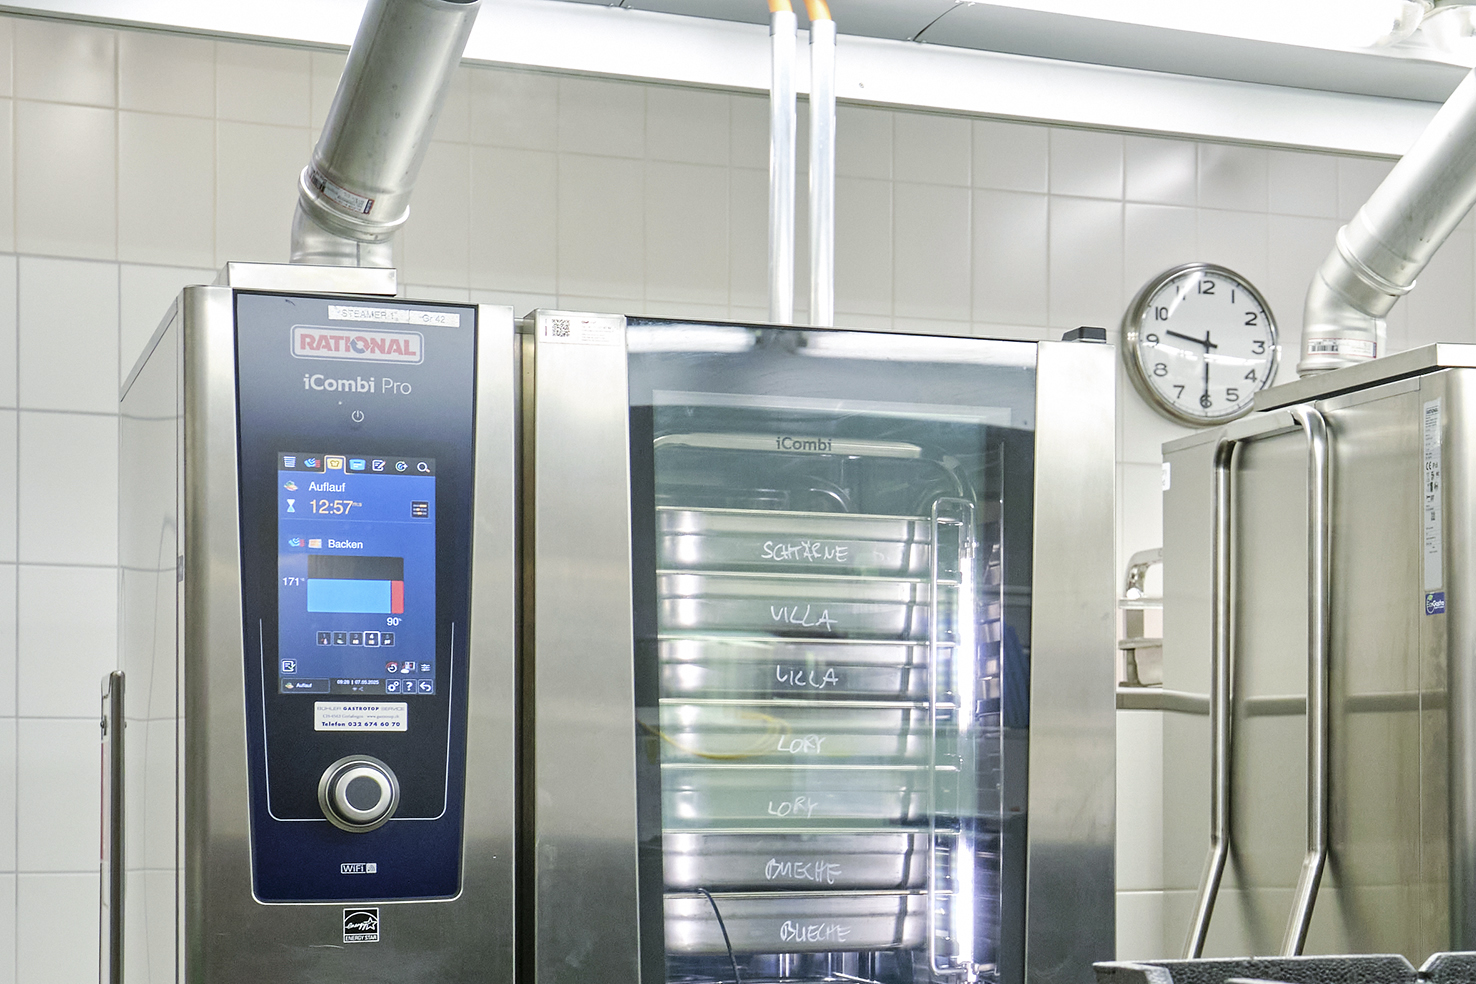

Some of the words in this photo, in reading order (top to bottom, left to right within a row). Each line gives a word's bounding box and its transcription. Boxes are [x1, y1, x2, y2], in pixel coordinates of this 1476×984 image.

[1198, 280, 1216, 295] 12
[1231, 289, 1235, 304] 1
[1155, 306, 1169, 321] 10
[1244, 312, 1258, 326] 2
[299, 333, 417, 357] RATIONAL
[1146, 333, 1160, 347] 9
[1251, 340, 1266, 355] 3
[1153, 363, 1168, 377] 8
[1244, 369, 1258, 383] 4
[303, 373, 375, 393] iCombi
[381, 378, 412, 395] Pro
[1173, 385, 1185, 399] 7
[1225, 388, 1239, 402] 5
[776, 436, 832, 451] iCombi
[308, 481, 346, 492] Auflauf
[309, 499, 352, 515] 12:57
[328, 539, 364, 549] Backen
[770, 604, 838, 632] VILLA
[342, 864, 364, 873] WiFi
